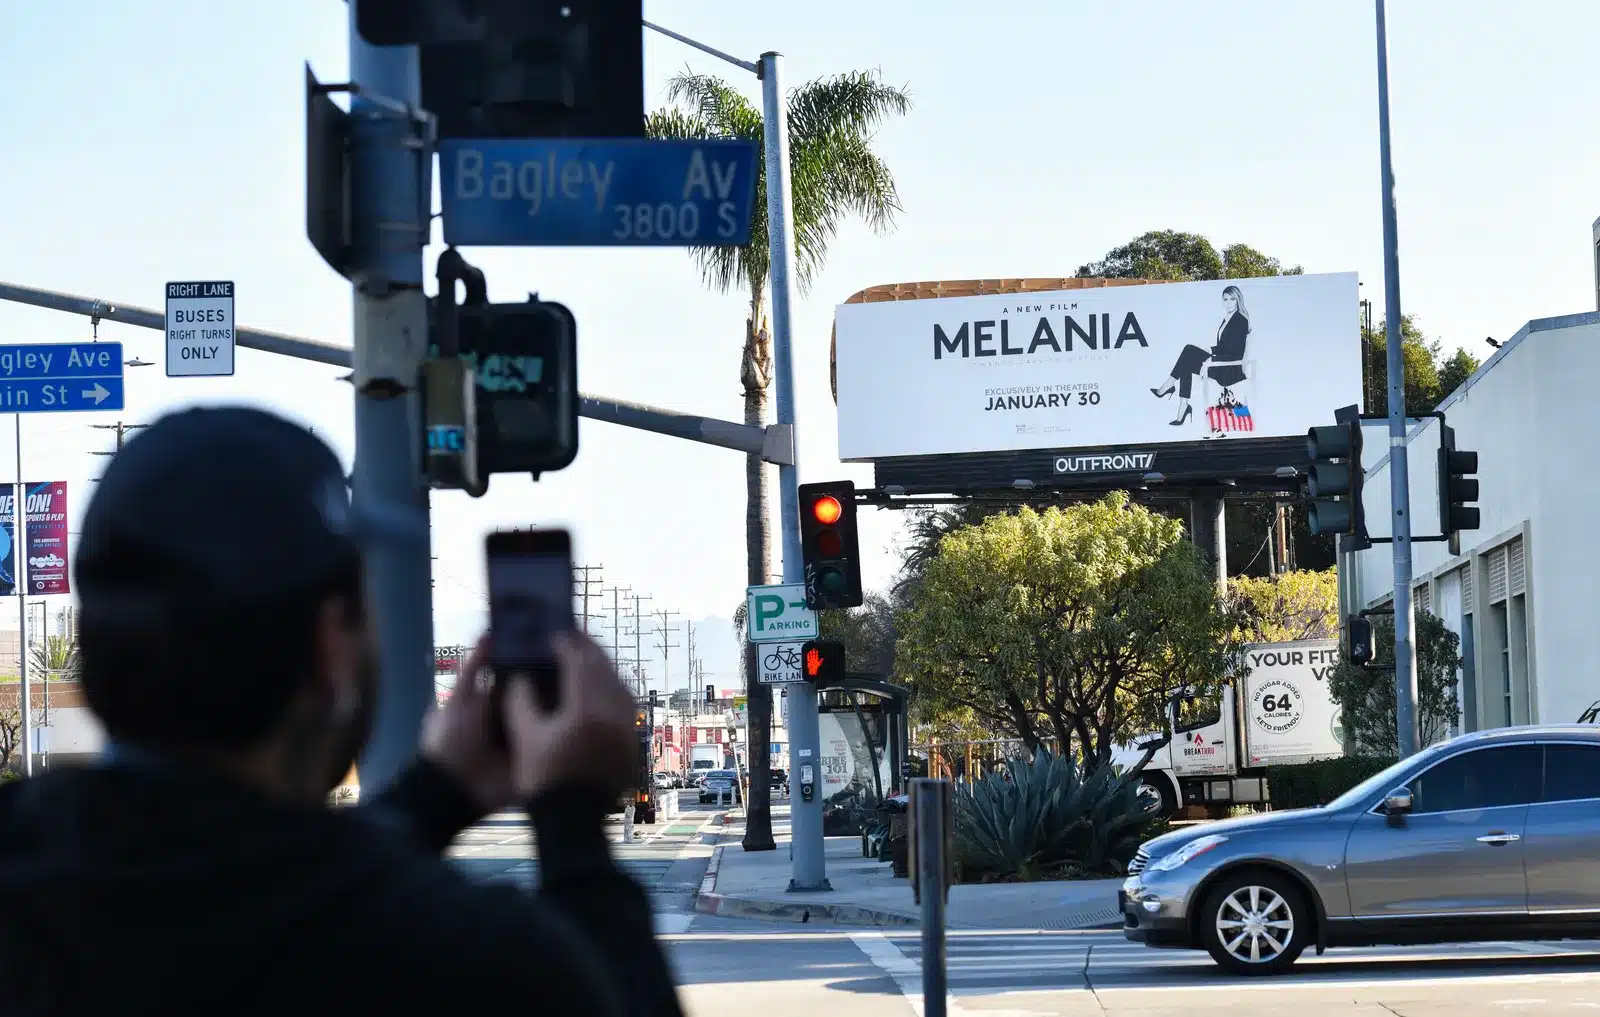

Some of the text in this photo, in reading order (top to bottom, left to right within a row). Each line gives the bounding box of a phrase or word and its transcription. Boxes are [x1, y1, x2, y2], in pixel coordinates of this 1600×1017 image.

[456, 148, 737, 216] Bagley Av
[613, 202, 736, 238] 3800 S
[169, 283, 231, 296] RIGHT LANE
[175, 309, 225, 323] BUSES
[1016, 305, 1042, 313] NEW
[1050, 303, 1078, 311] FILM
[170, 328, 231, 340] RIGHT TURNS
[933, 311, 1149, 360] MELANIA
[0, 347, 111, 376] gley Ave
[181, 346, 219, 360] ONLY
[0, 384, 68, 406] in St
[984, 386, 1040, 396] EXCLUSIVELY
[1055, 382, 1099, 392] THEATERS
[984, 391, 1100, 411] JANUARY 30
[26, 493, 52, 514] ON!
[51, 513, 64, 521] PLAY
[1250, 651, 1303, 667] YOUR
[764, 672, 802, 681] BIKE LAN
[1253, 680, 1301, 702] NO SUGAR ADDED
[1262, 694, 1292, 712] 64
[1256, 711, 1301, 732] KETO FRIENDLY
[1263, 711, 1292, 719] CALORIES
